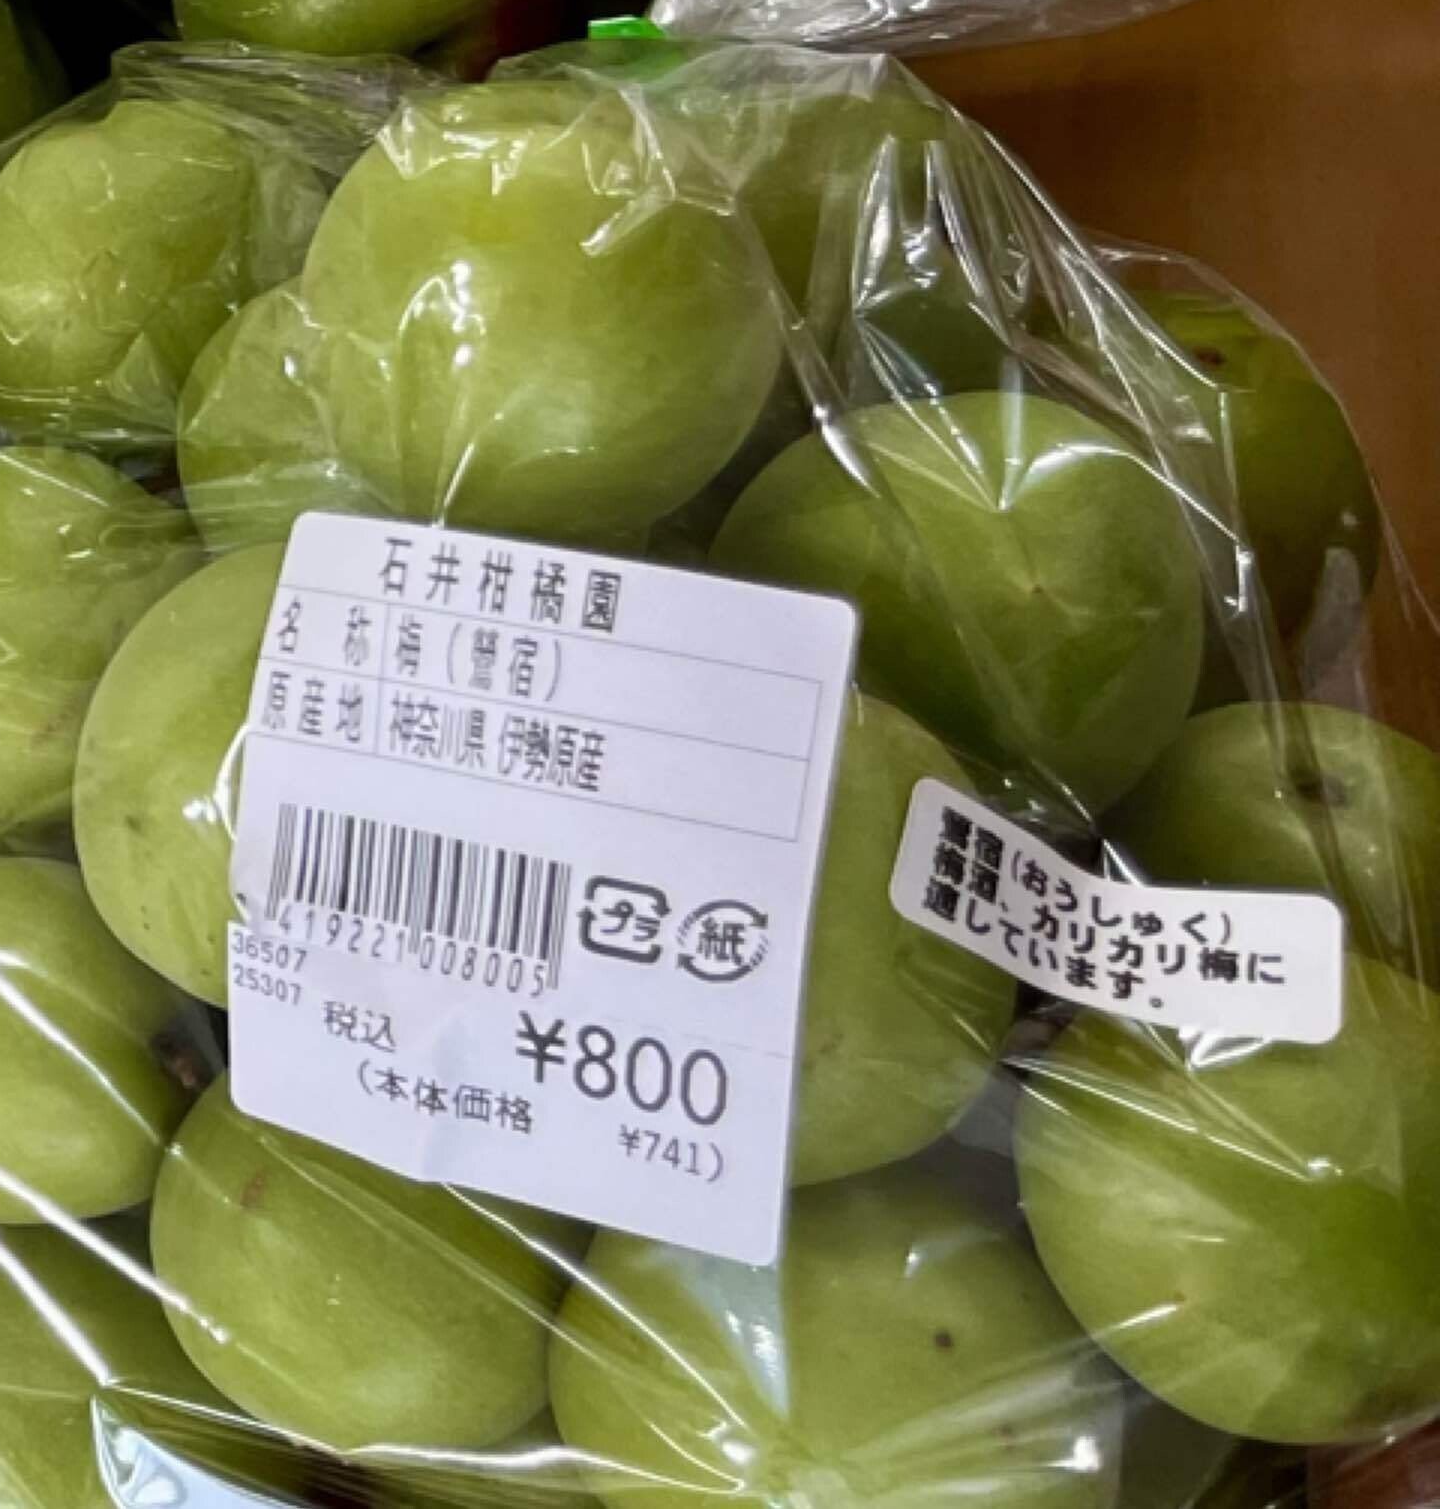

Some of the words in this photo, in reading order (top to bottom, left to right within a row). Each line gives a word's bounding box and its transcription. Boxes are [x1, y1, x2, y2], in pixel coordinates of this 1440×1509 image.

[379, 537, 622, 634] 石井柑橘園
[261, 670, 363, 744] 原産地
[231, 929, 308, 974] 36507
[696, 916, 746, 968] 紙
[231, 962, 303, 1006] 25307
[322, 1000, 396, 1054] 税込
[357, 1058, 532, 1135] (本体価格
[515, 1010, 728, 1127] ¥800
[616, 1123, 725, 1183] ¥741)
